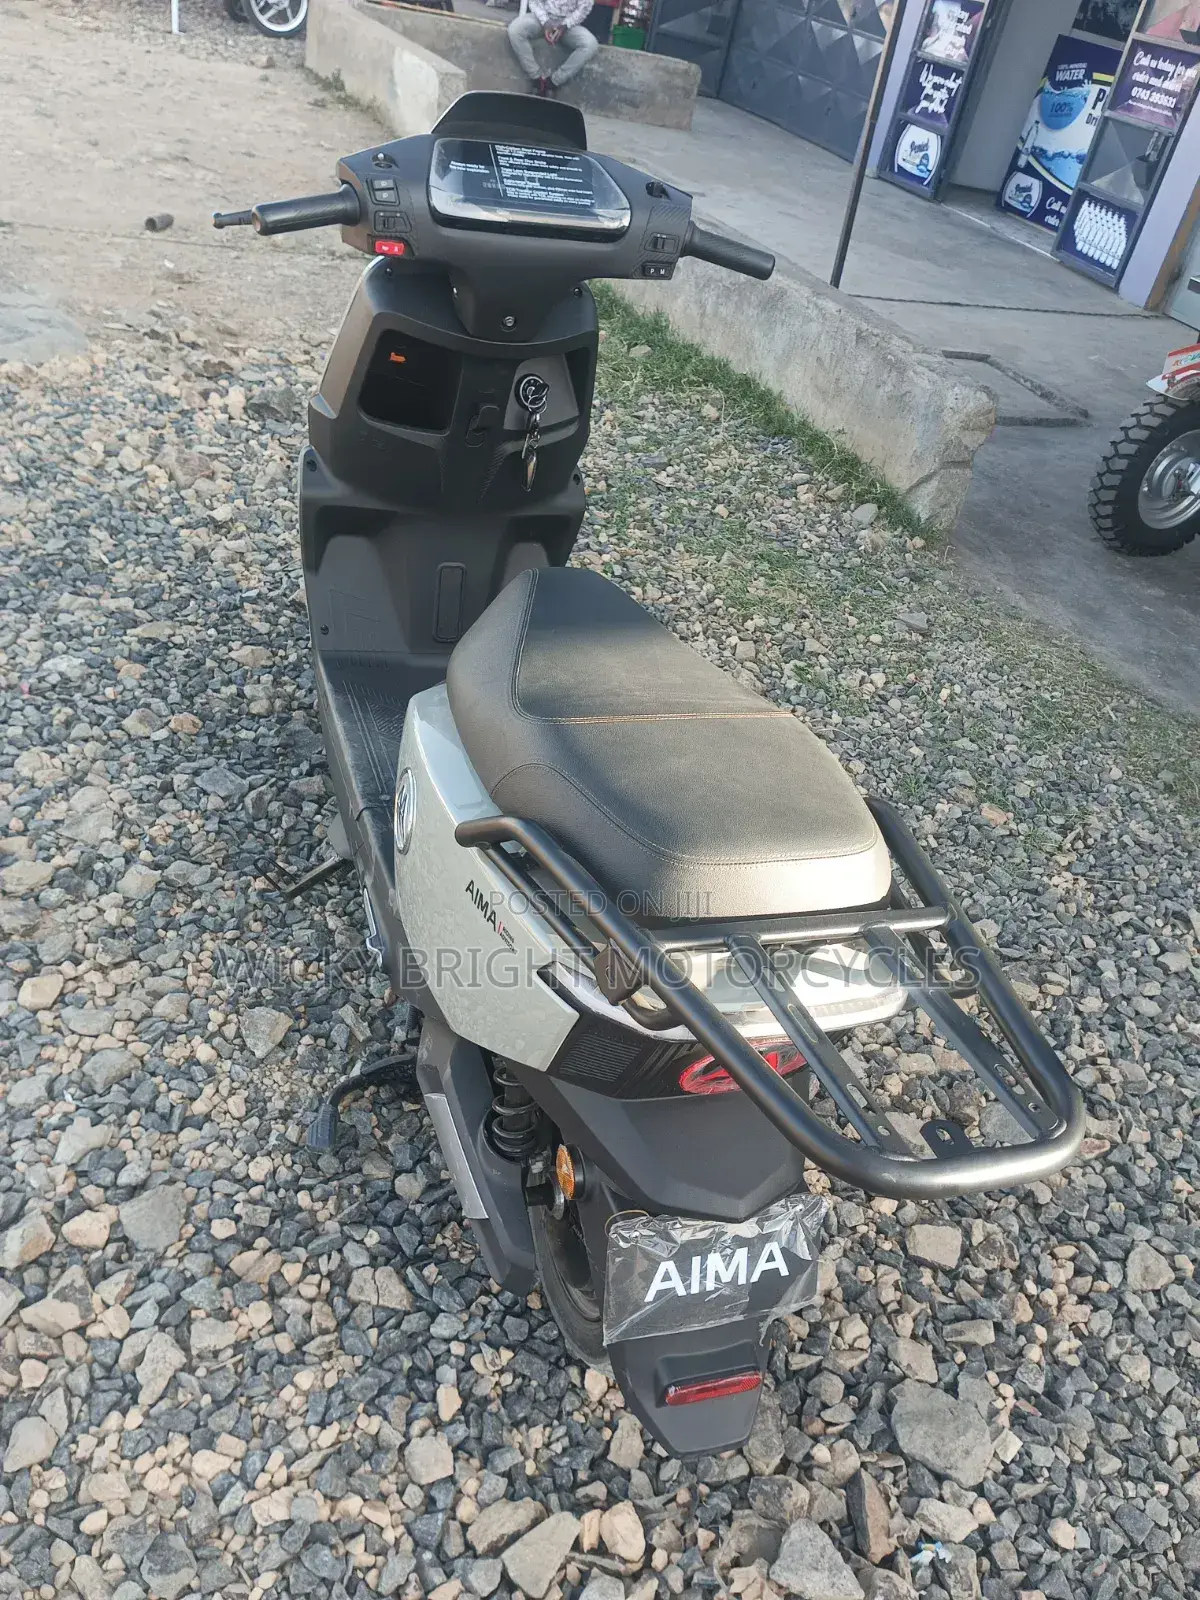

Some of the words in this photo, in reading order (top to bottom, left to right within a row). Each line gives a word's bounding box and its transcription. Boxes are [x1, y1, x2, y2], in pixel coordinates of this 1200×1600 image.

[1056, 69, 1085, 82] WATER
[1131, 86, 1150, 100] 0743
[465, 880, 497, 932] AIMA
[644, 1241, 790, 1303] AIMA
